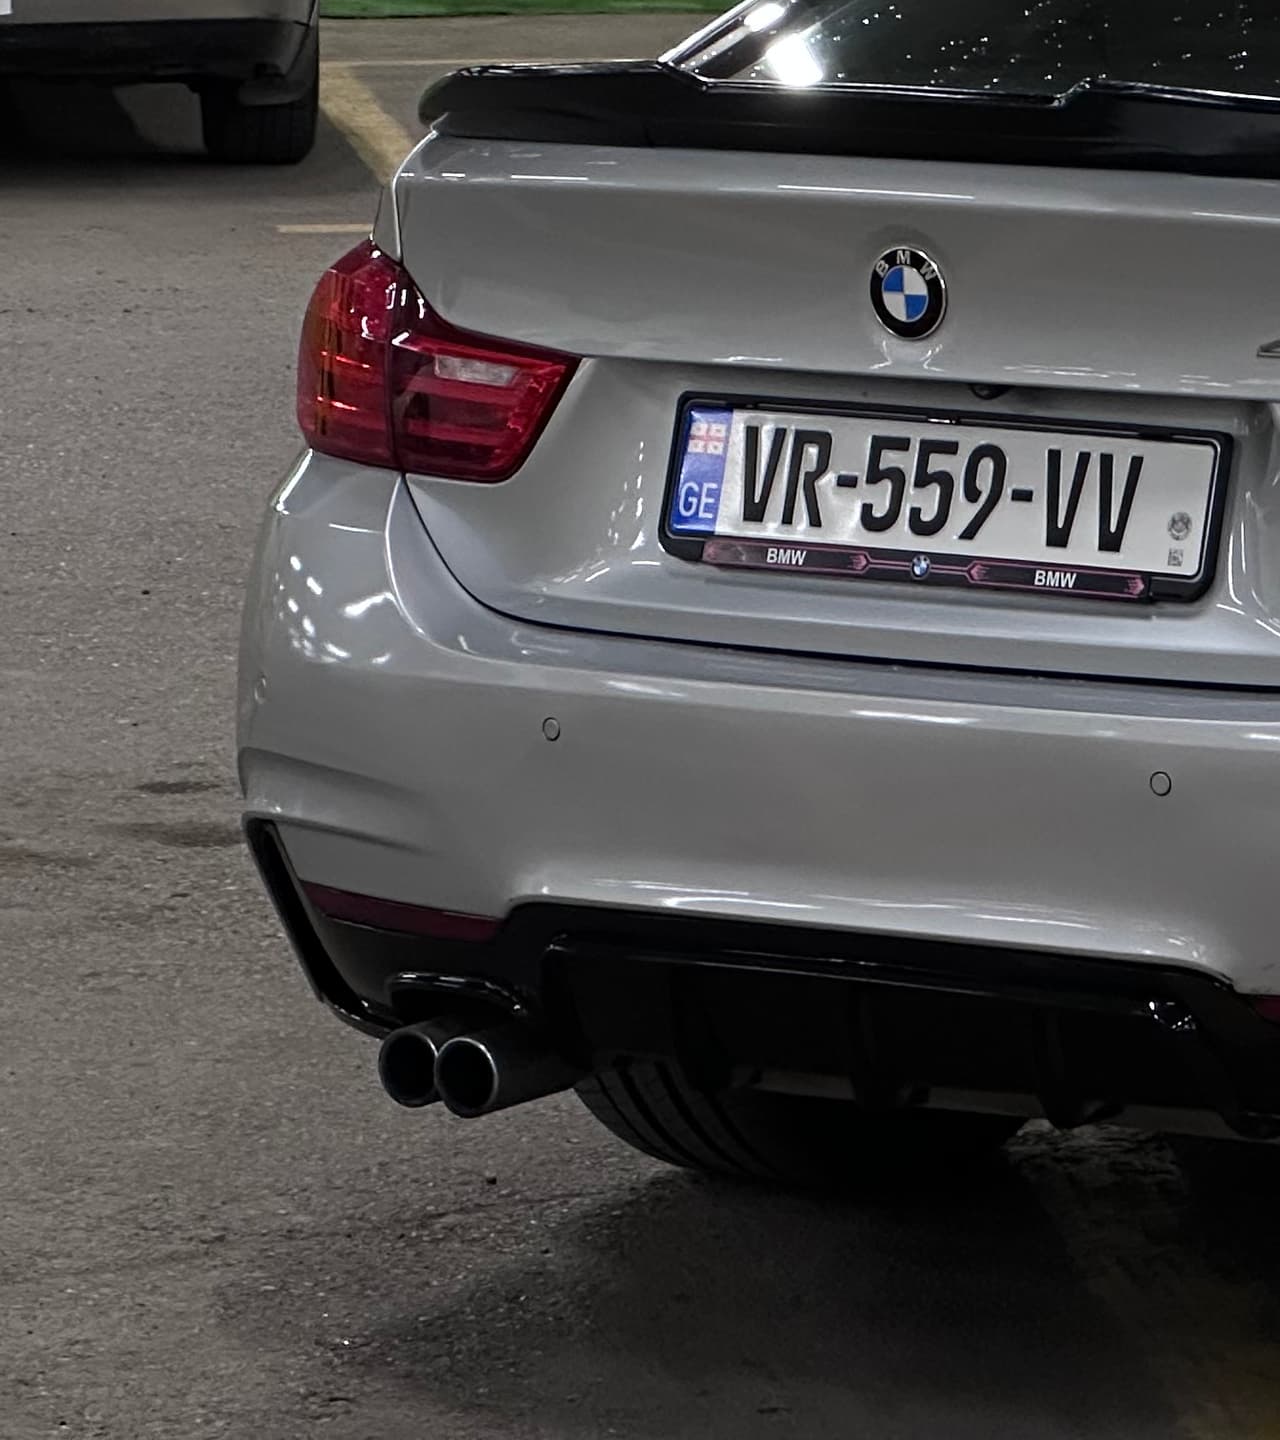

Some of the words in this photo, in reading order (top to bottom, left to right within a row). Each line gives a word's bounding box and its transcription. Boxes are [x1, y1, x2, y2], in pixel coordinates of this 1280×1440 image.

[875, 250, 937, 280] BMW
[678, 481, 719, 520] GE
[740, 424, 1144, 553] VR-559-VV
[766, 548, 807, 566] BMW
[1033, 569, 1077, 589] BMW
